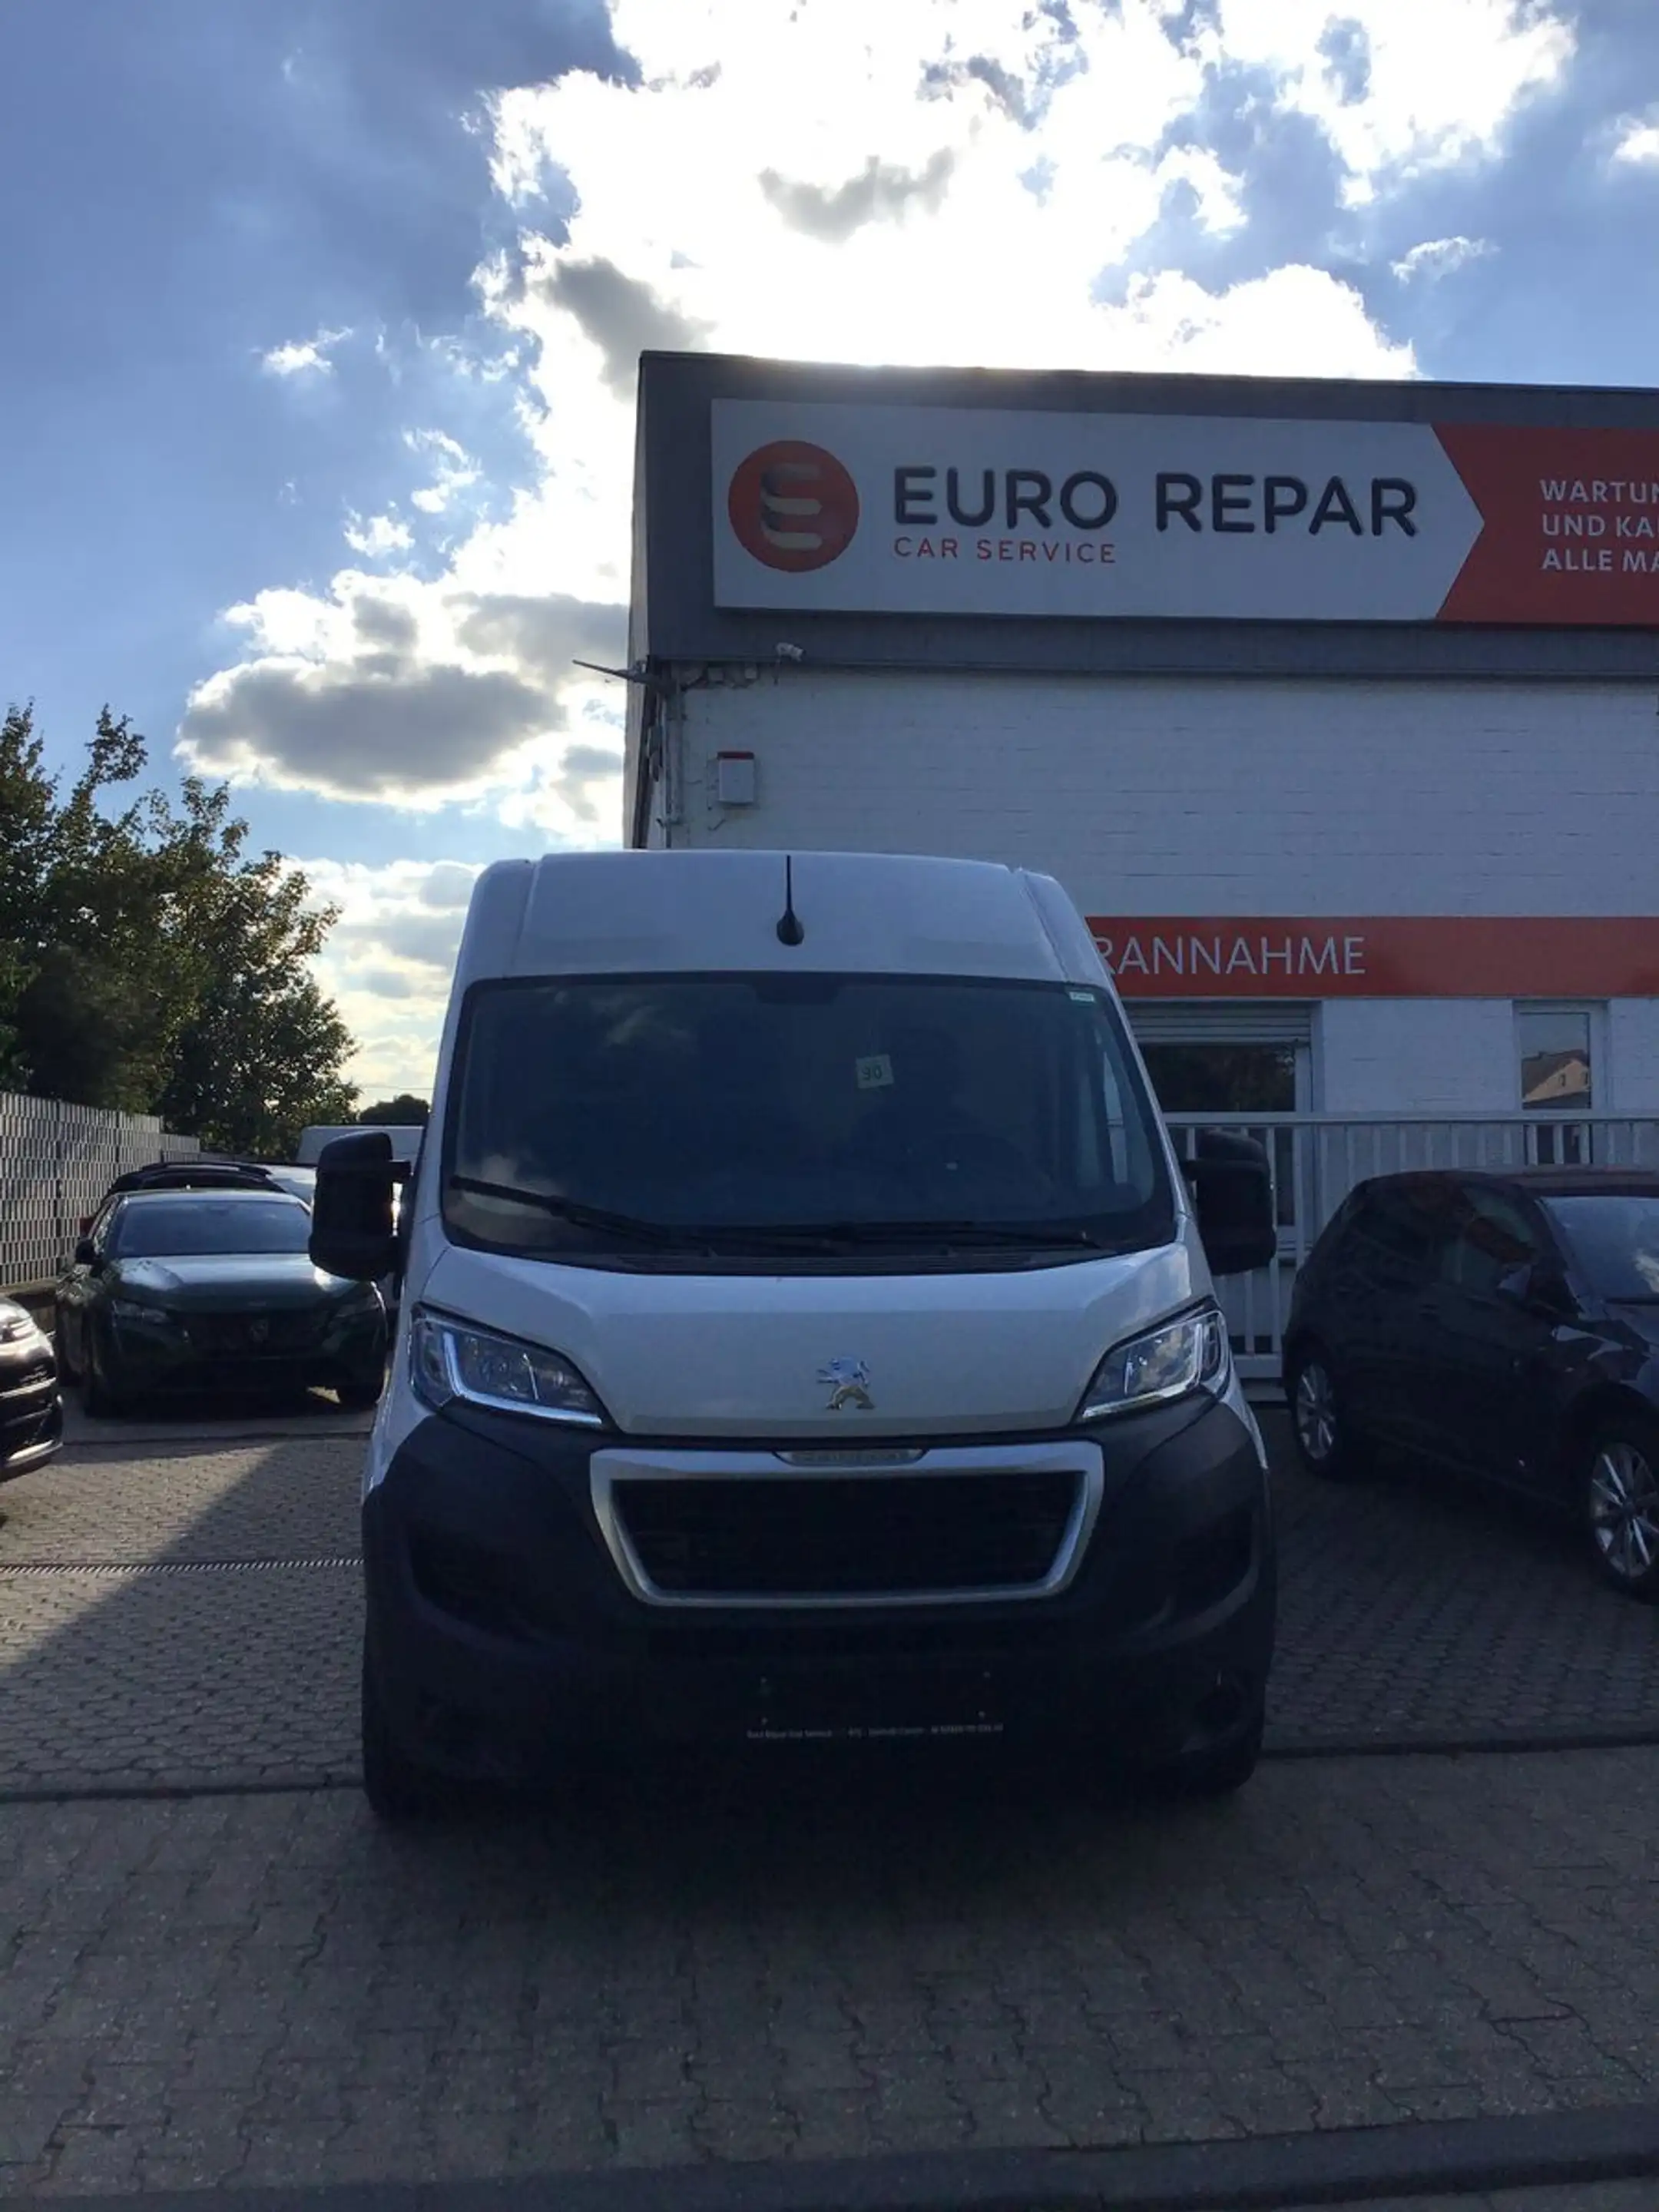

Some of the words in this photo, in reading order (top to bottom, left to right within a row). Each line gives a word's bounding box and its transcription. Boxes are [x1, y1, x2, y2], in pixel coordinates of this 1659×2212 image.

[894, 466, 1118, 530] EURO
[1156, 472, 1416, 537] REPAR
[1542, 513, 1605, 537] UND
[894, 537, 958, 558] CAR
[977, 539, 1116, 564] SERVICE
[1541, 548, 1613, 571] ALLE
